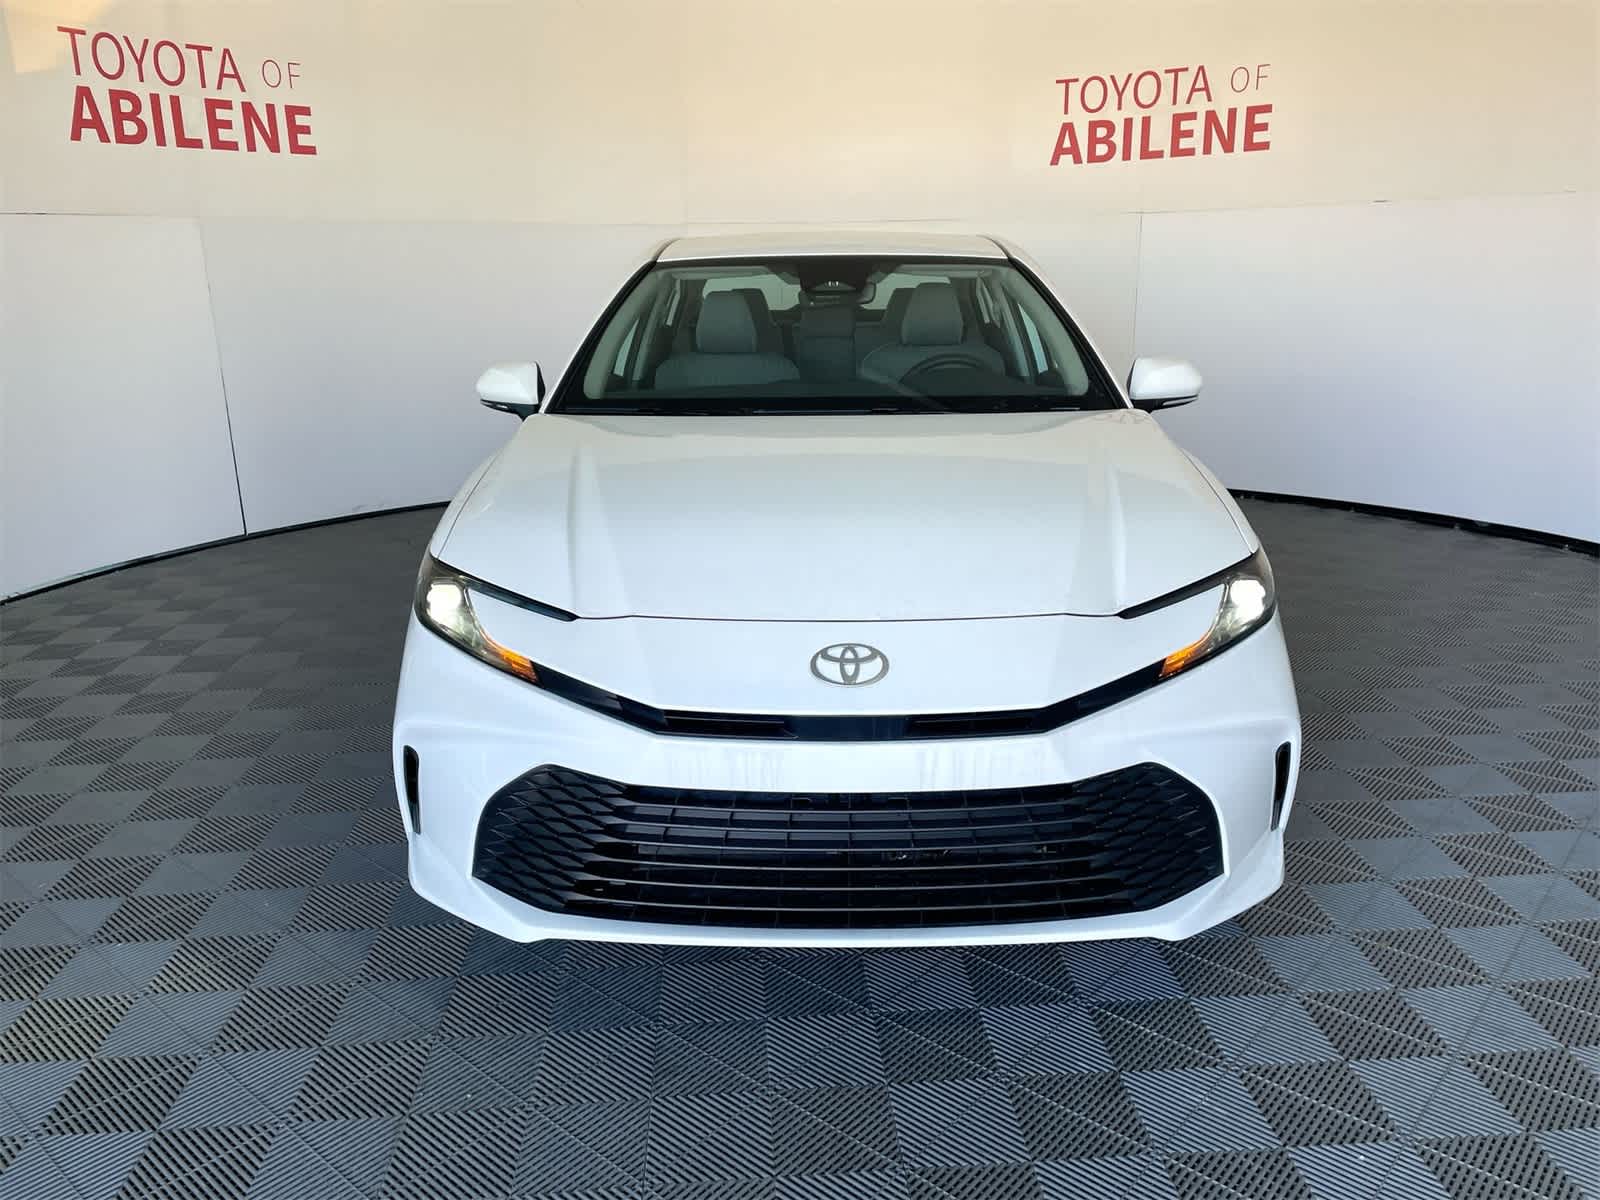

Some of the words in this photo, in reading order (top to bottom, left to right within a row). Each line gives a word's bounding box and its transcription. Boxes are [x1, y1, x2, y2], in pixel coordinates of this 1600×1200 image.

[56, 25, 246, 93] TOYOTA
[261, 59, 301, 89] OF
[1055, 65, 1213, 115] TOYOTA
[1230, 63, 1271, 93] OF
[69, 85, 318, 156] ABILENE
[1049, 103, 1273, 166] ABILENE
